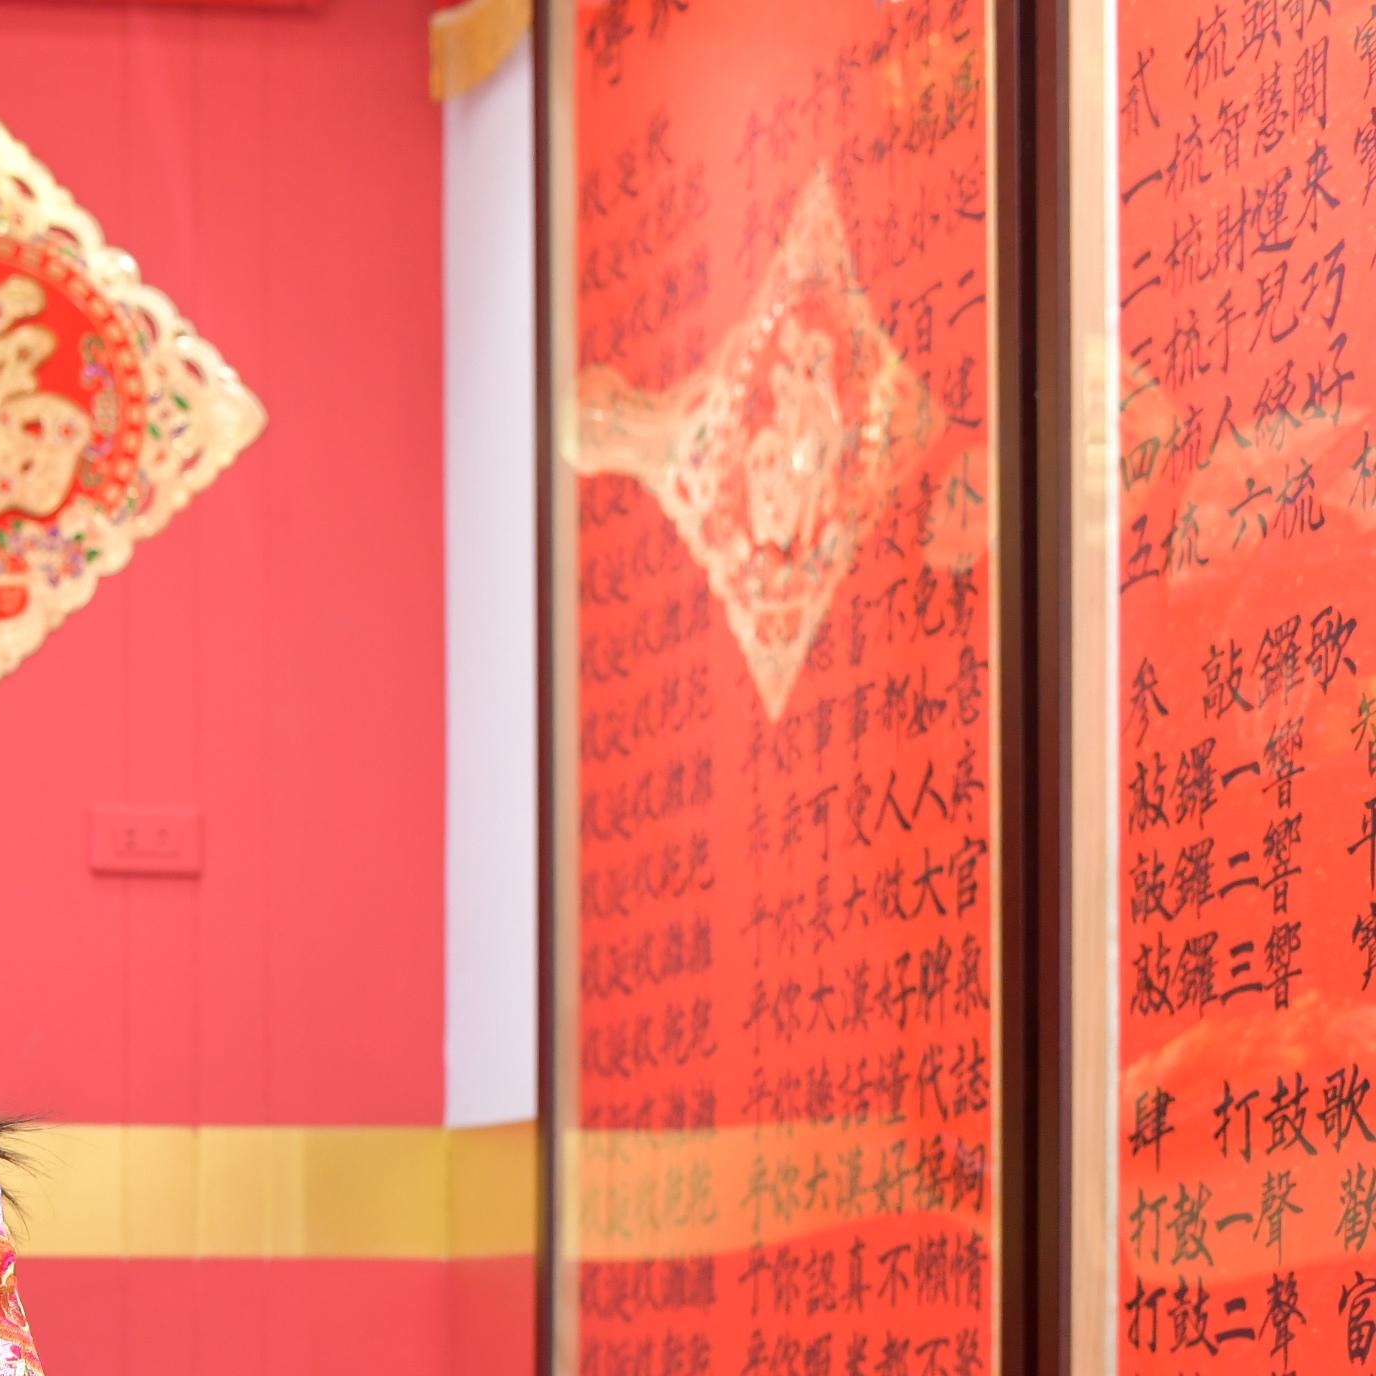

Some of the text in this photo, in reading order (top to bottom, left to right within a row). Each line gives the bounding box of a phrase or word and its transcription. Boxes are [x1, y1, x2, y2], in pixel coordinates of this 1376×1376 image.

[1211, 1063, 1376, 1164] 打鼓歌
[1128, 1170, 1303, 1266] 打鼓一聲
[1125, 1271, 1307, 1369] 打鼓二聲
